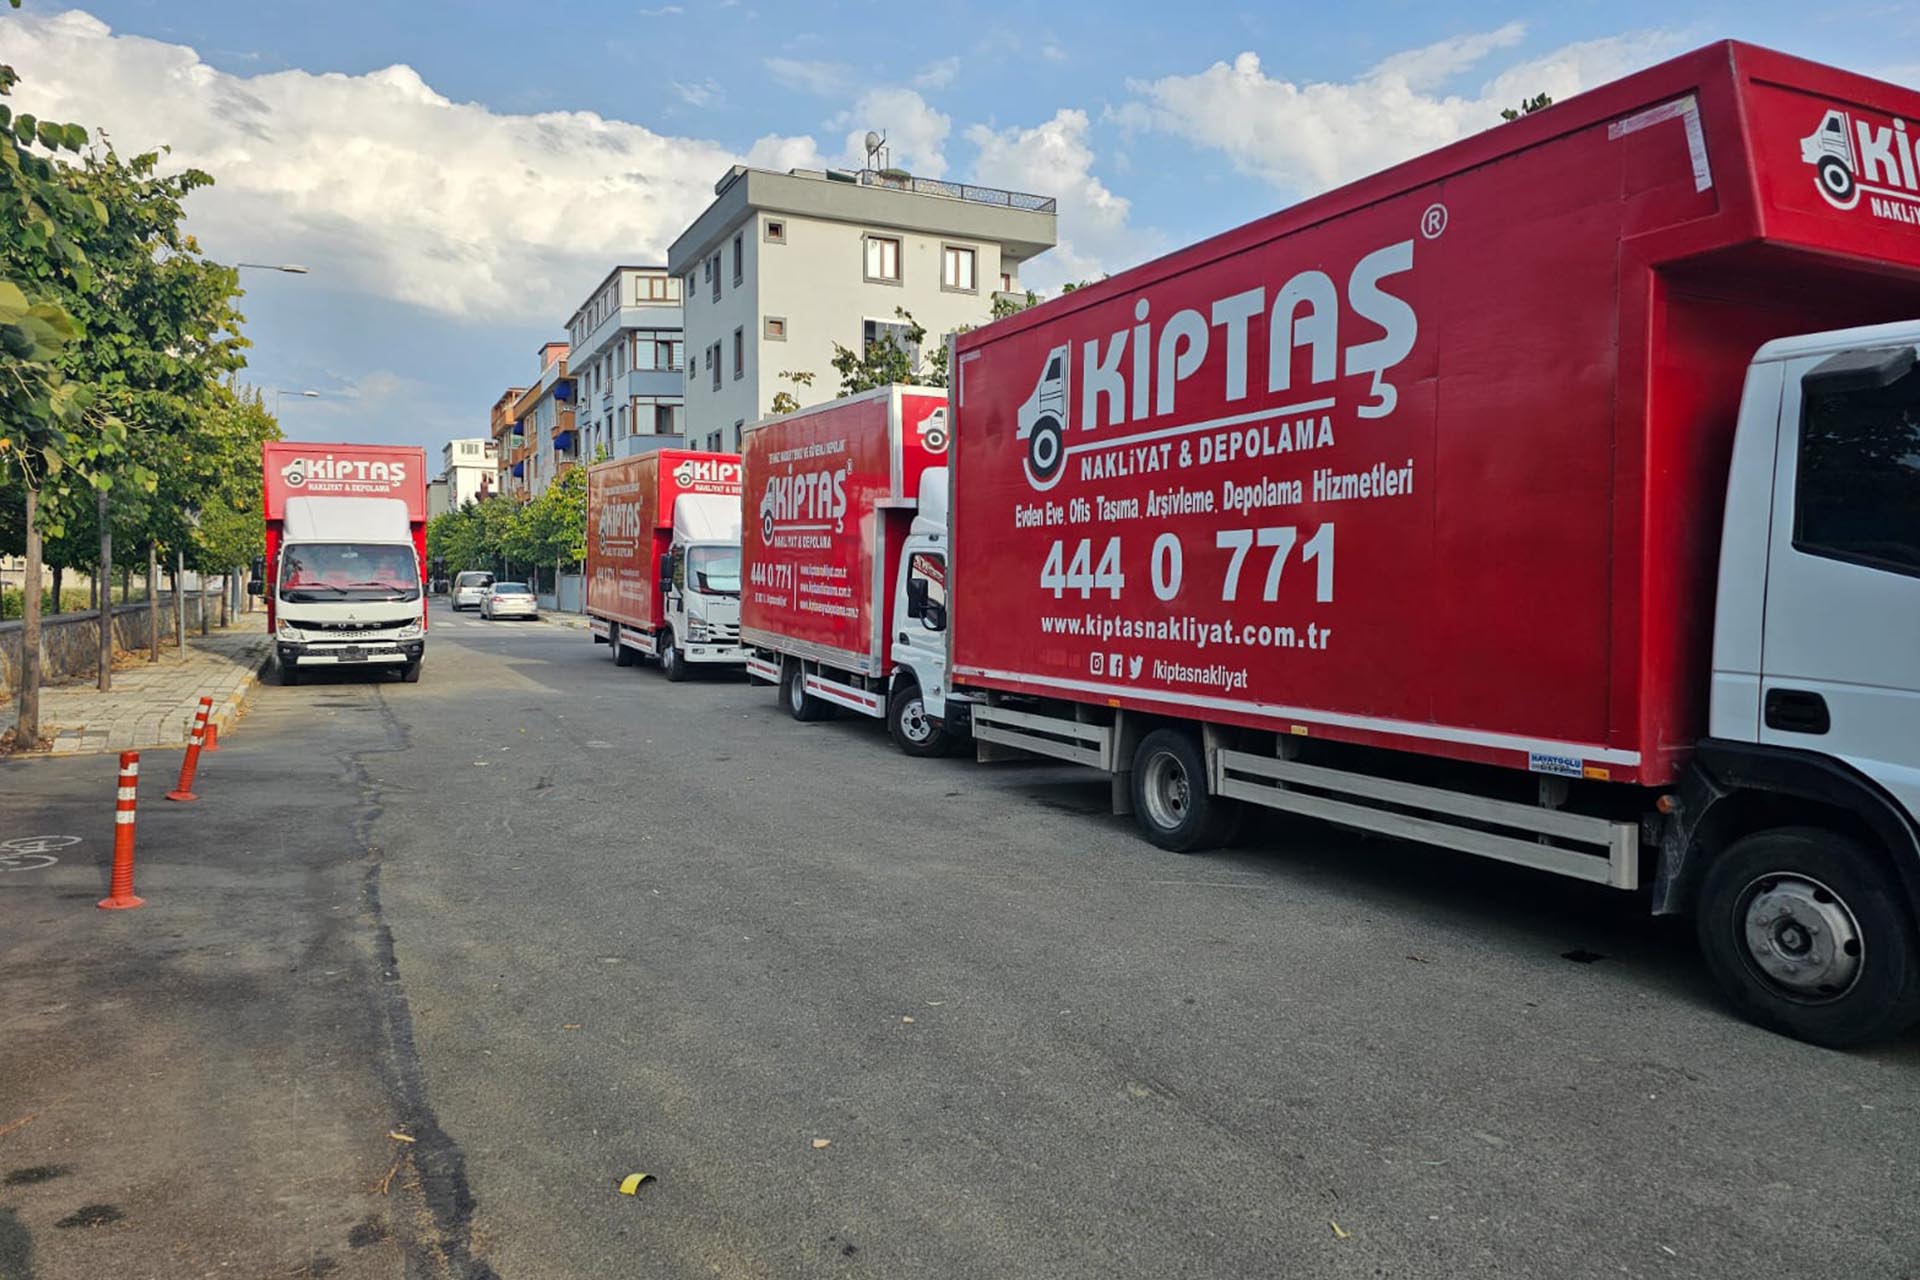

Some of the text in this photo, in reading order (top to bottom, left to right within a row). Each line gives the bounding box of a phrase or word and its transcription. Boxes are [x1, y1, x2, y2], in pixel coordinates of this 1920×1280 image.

[1856, 117, 1920, 191] Kİ
[1081, 239, 1418, 430] KİPTAŞ
[307, 454, 406, 487] KİPTAŞ
[1178, 440, 1193, 469] &
[1199, 415, 1335, 465] DEPOLAMA
[775, 463, 847, 534] KİPTAŞ
[1015, 503, 1043, 528] Evden
[1069, 497, 1091, 524] Ofis
[1223, 476, 1303, 516] Depolama
[1312, 458, 1414, 502] Hizmetleri
[750, 562, 766, 586] 444
[767, 563, 774, 587] 0
[775, 564, 792, 590] 771
[1040, 522, 1336, 603] 444 0 771
[1041, 613, 1331, 650] www.kiptasnakliyat.com.tr
[1152, 658, 1248, 693] /kiptasnakliyat
